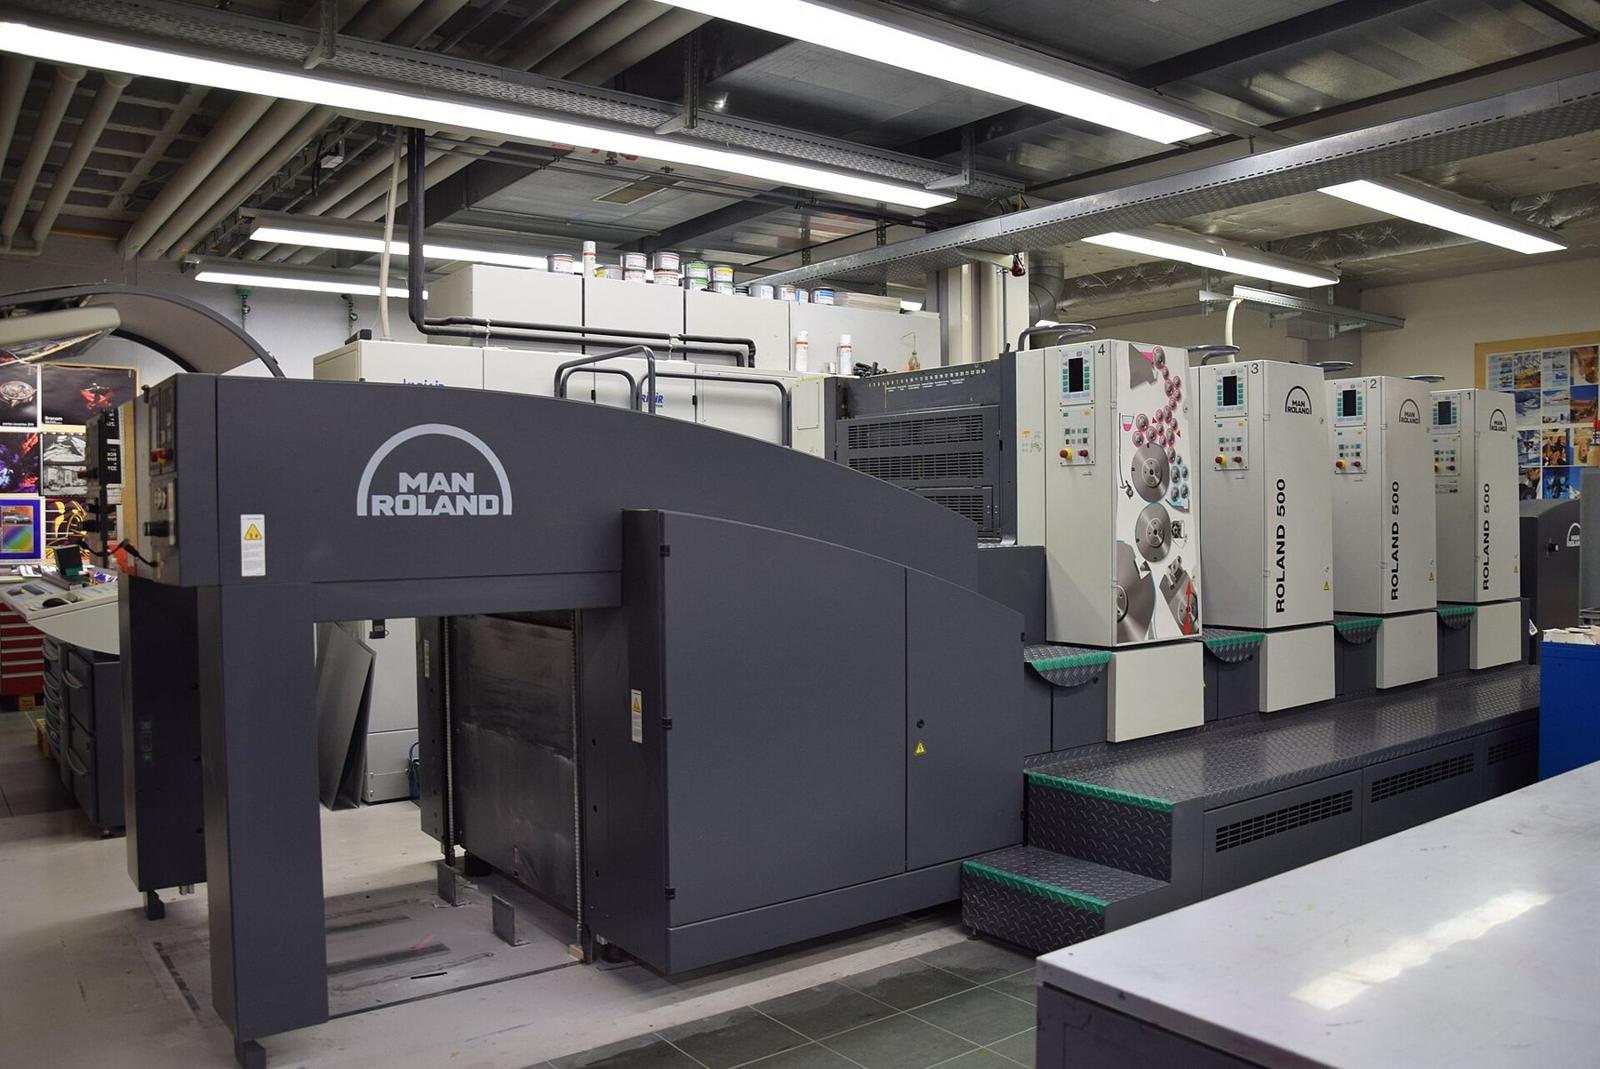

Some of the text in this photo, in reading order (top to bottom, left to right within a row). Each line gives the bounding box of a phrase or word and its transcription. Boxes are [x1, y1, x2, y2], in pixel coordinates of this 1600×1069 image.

[1097, 343, 1106, 356] 4
[1250, 362, 1259, 374] 3
[1369, 379, 1377, 389] 2
[1466, 392, 1472, 400] 1
[1291, 399, 1306, 408] MAN
[1287, 406, 1310, 415] ROLAND
[398, 472, 475, 493] MAN
[371, 494, 500, 516] ROLAND
[1390, 481, 1400, 601] ROLAND 500
[1482, 483, 1491, 590] ROLAND 500
[1275, 478, 1286, 613] ROLAND 500
